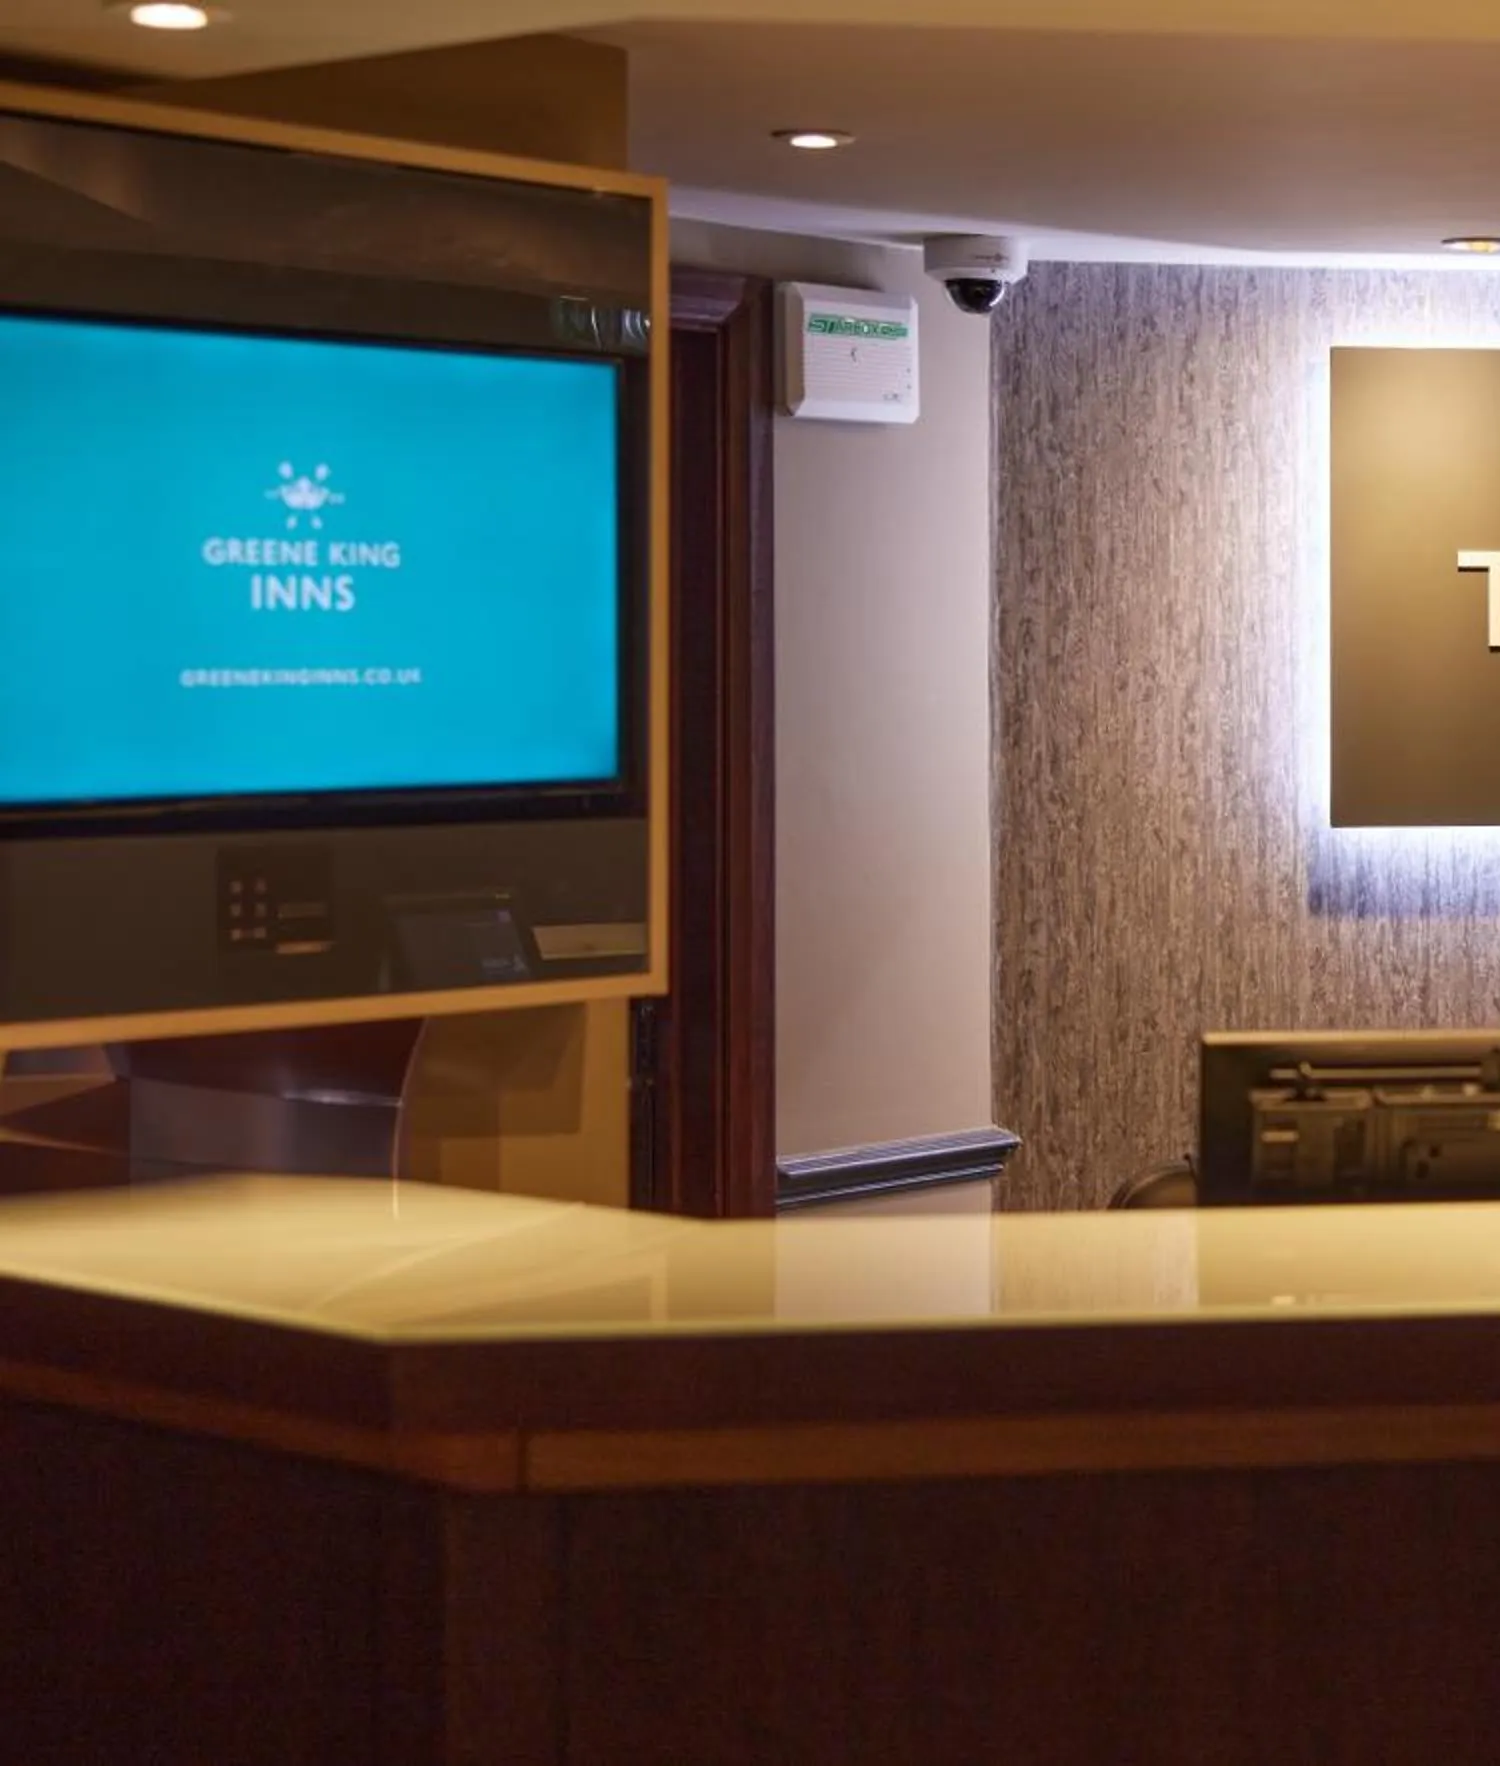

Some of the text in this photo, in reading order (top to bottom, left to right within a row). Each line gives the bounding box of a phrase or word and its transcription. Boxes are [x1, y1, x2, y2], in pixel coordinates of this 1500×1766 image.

[202, 537, 402, 569] GREENE KING
[250, 573, 356, 612] INNS
